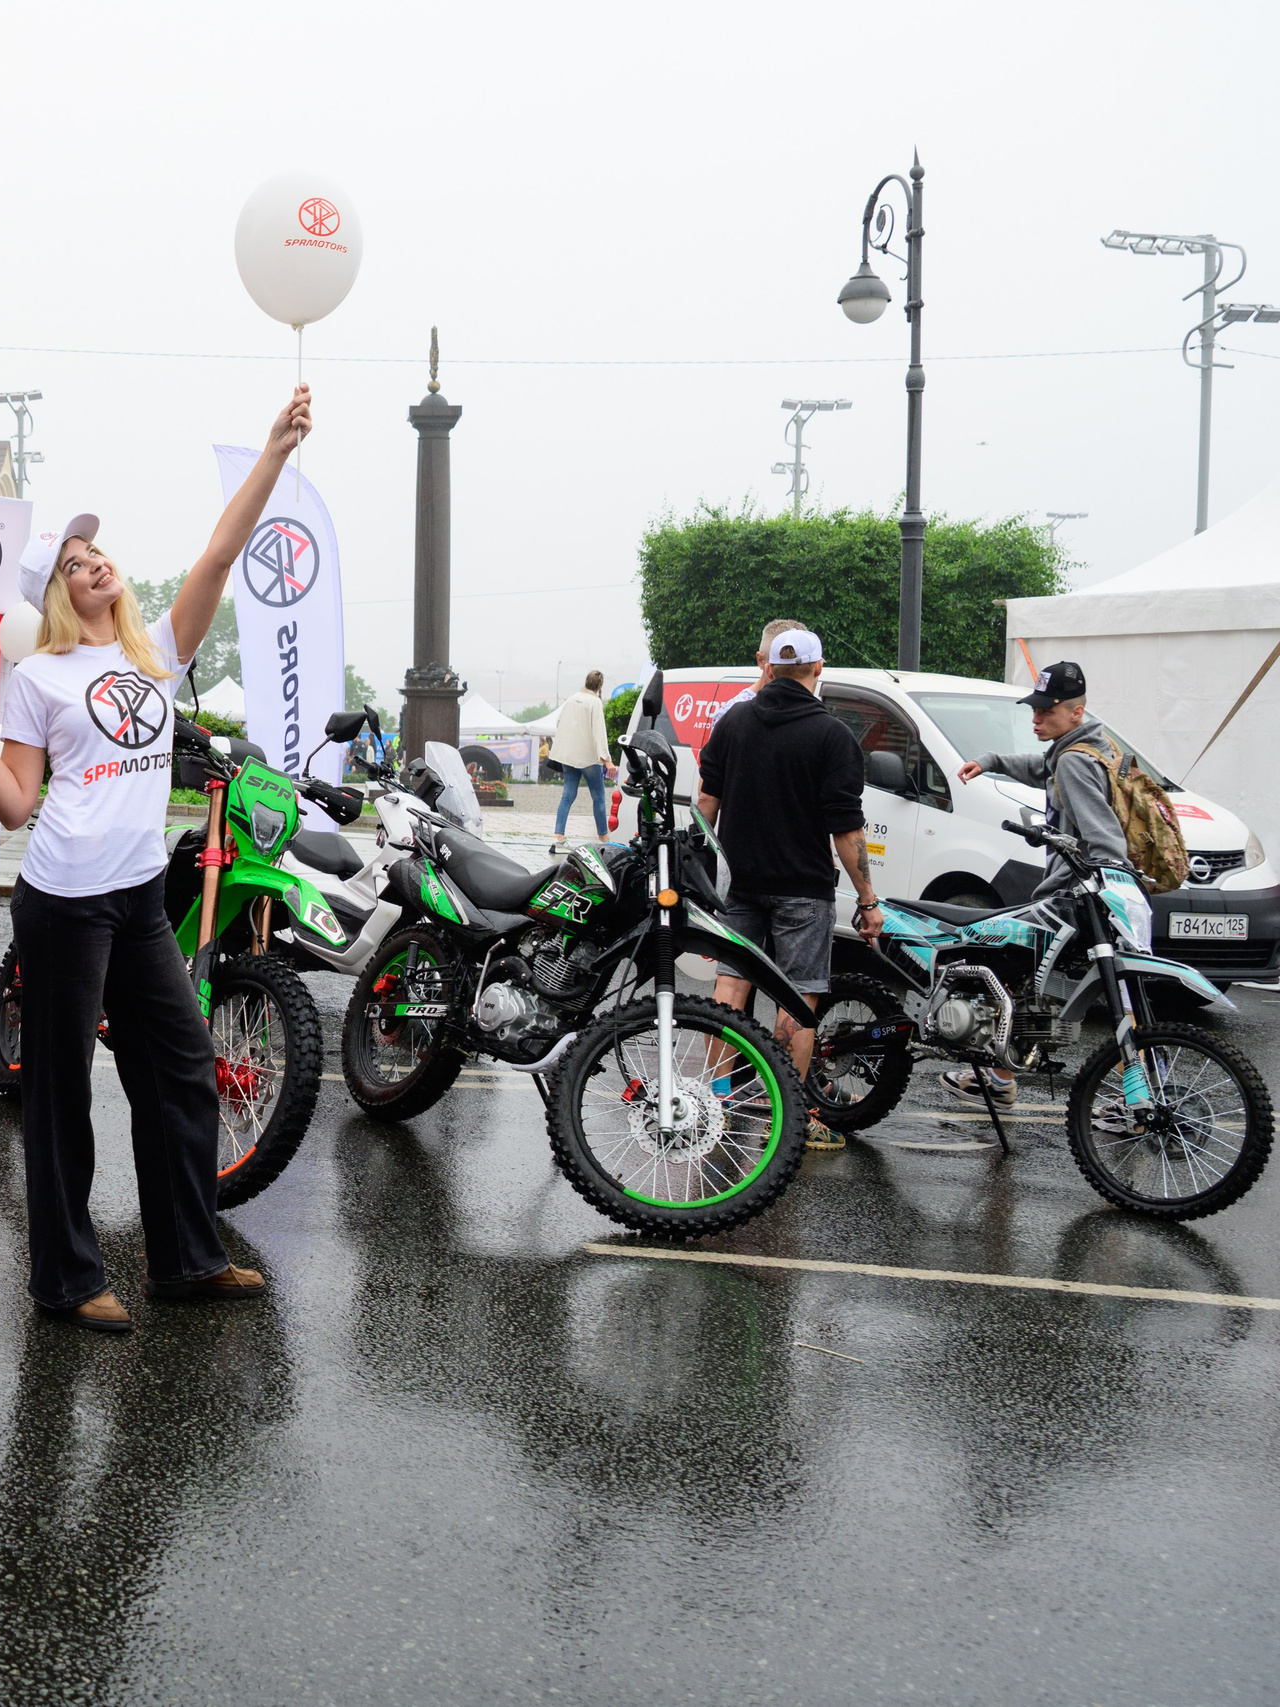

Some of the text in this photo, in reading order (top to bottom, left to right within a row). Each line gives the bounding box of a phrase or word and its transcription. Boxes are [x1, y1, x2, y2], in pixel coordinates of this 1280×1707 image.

[284, 238, 348, 254] SPRMOTORS
[245, 775, 292, 800] SPR
[439, 843, 452, 861] SPR
[979, 919, 1000, 930] SPR
[1226, 918, 1244, 931] 125
[405, 1006, 438, 1014] PRO
[881, 1025, 897, 1036] SPR
